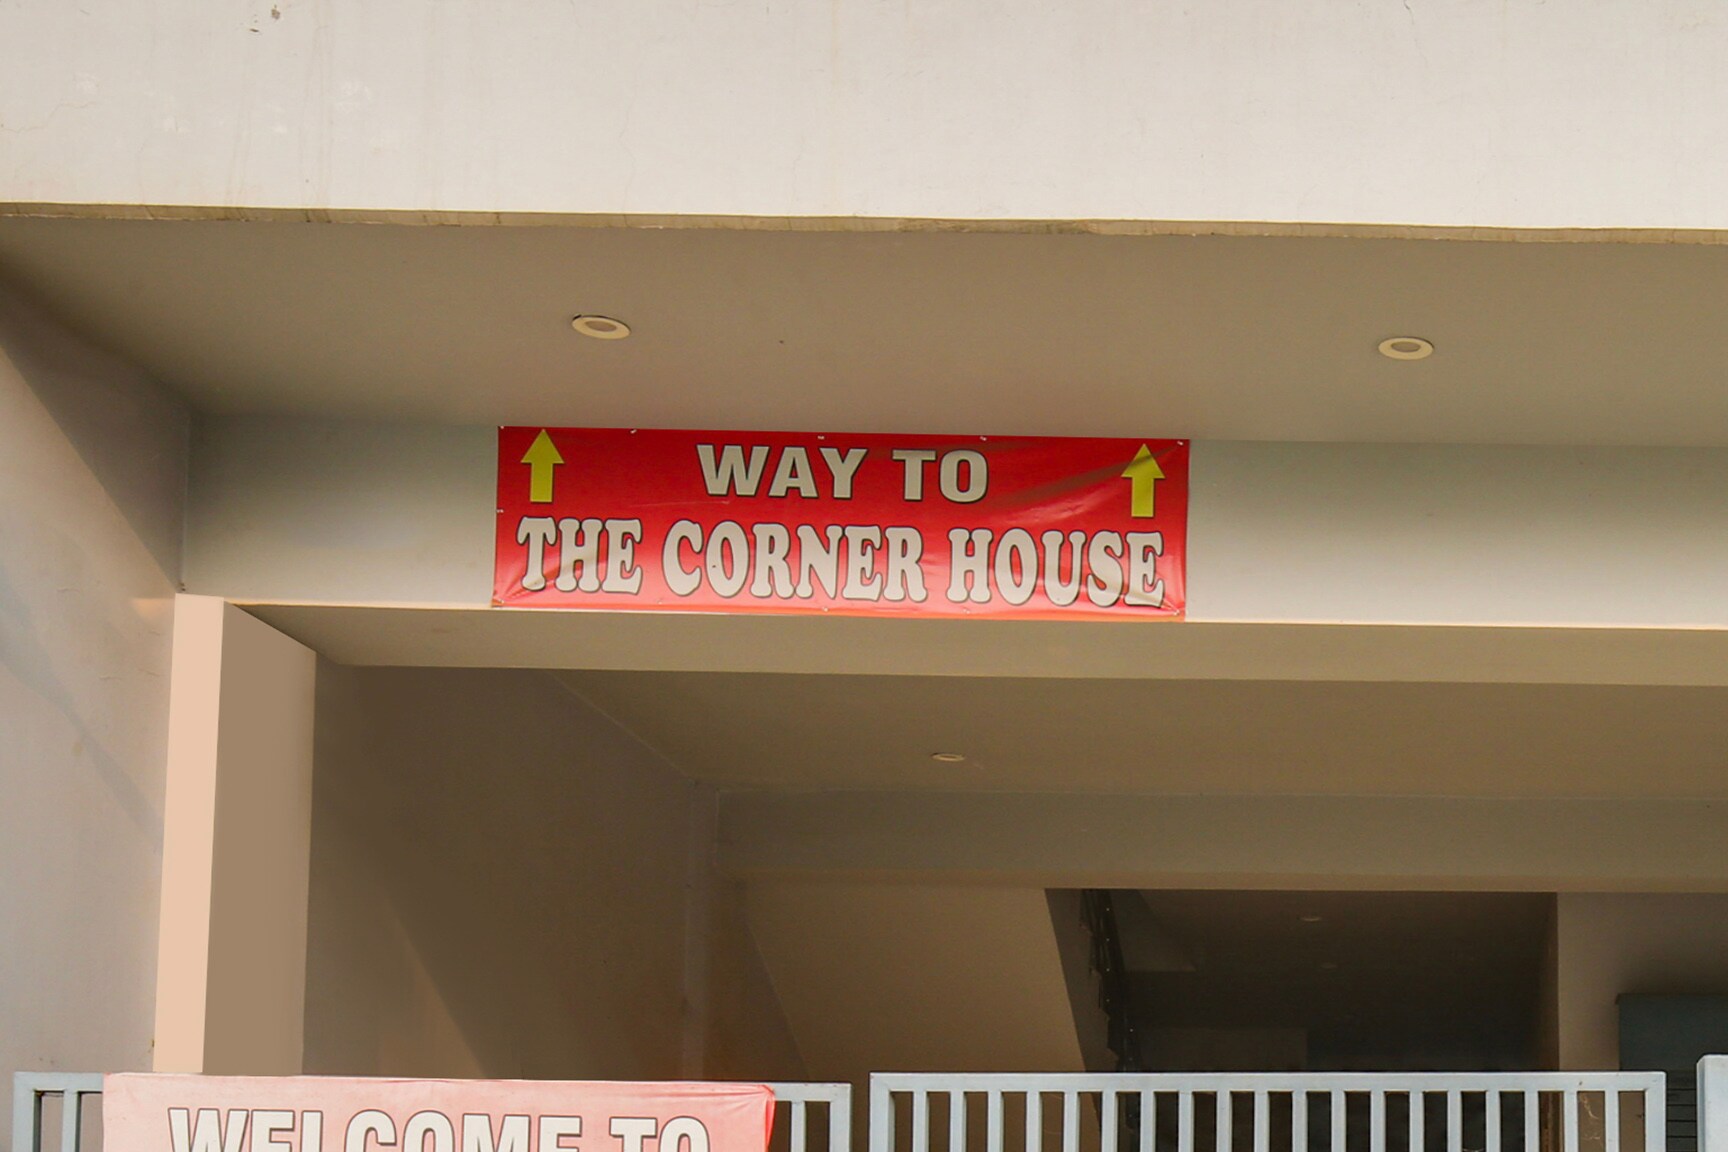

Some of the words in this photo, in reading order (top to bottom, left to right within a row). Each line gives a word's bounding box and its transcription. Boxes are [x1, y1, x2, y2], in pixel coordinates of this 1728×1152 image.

[696, 444, 869, 499] WAY
[892, 449, 989, 503] TO
[516, 516, 644, 595] THE
[661, 519, 928, 603] CORNER
[946, 528, 1166, 608] HOUSE
